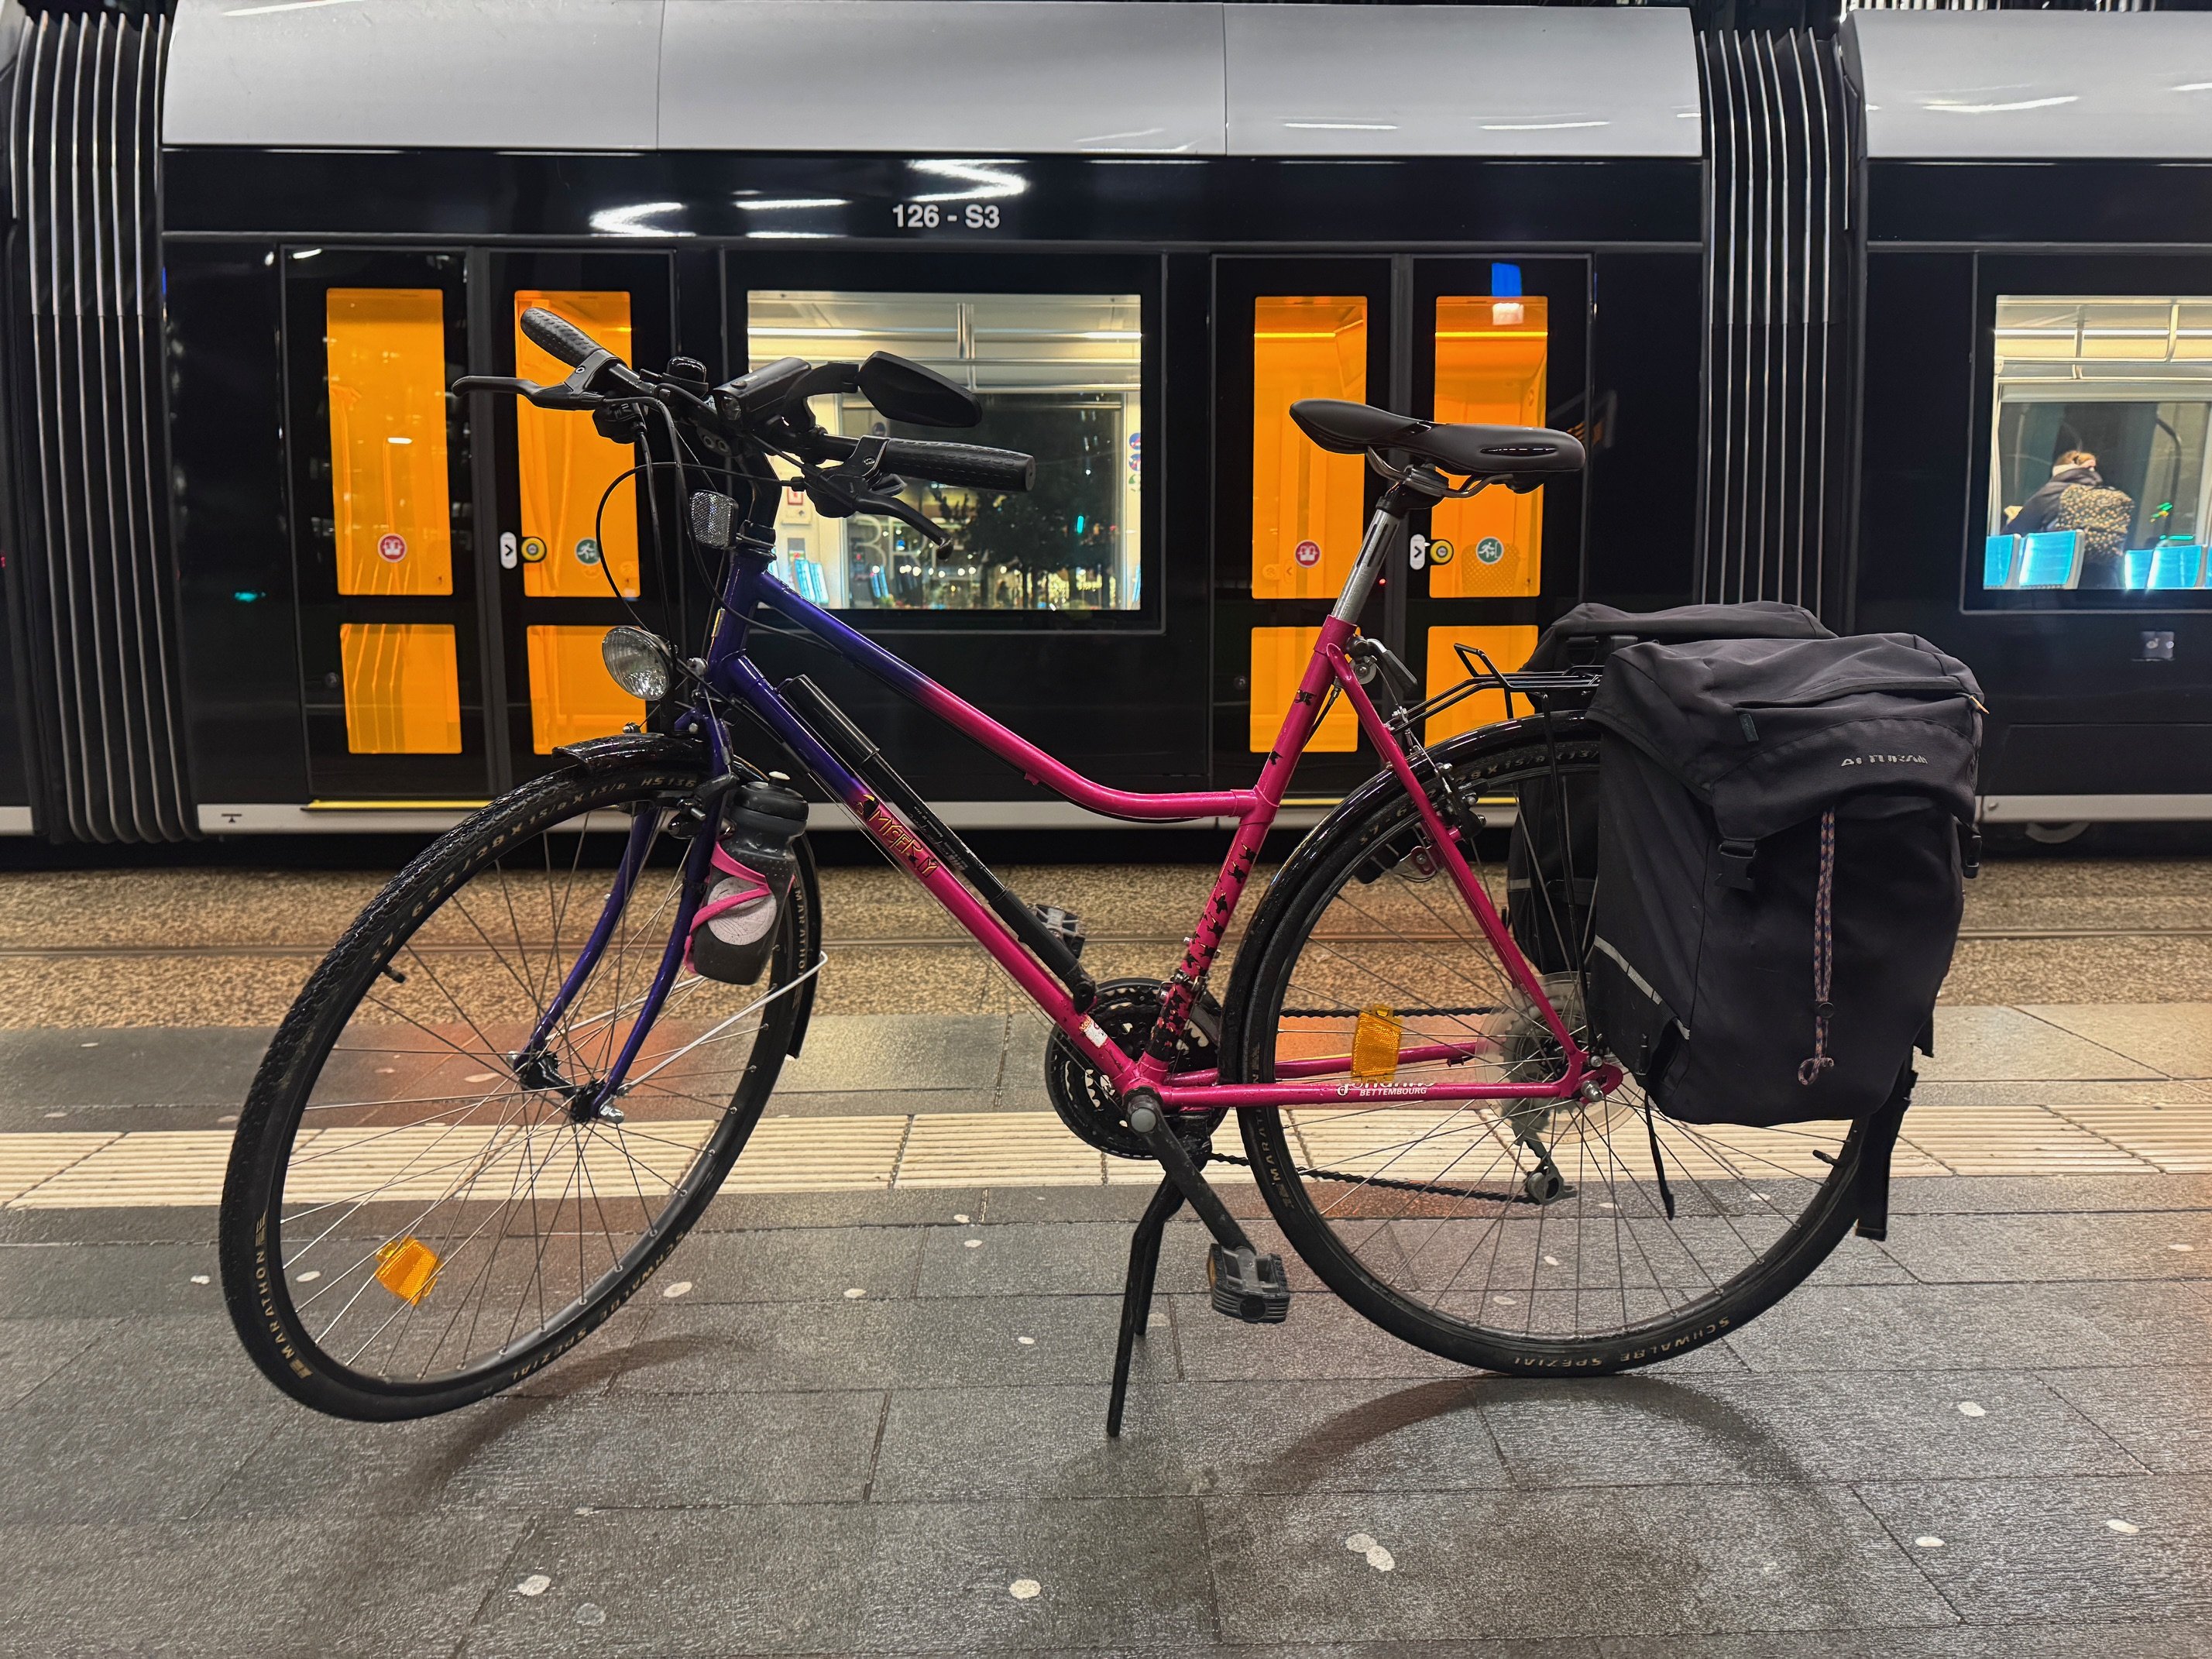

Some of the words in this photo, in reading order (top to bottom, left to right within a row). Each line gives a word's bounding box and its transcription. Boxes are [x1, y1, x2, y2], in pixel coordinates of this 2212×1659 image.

[892, 204, 939, 228] 126
[965, 204, 1001, 228] S3
[795, 890, 806, 976] MARATHO
[1359, 1087, 1427, 1097] BETTEMBOURG
[256, 1250, 295, 1359] MARATHON
[1620, 1316, 1730, 1362] SCHWALBE
[1513, 1357, 1602, 1368] SPEZIAL
